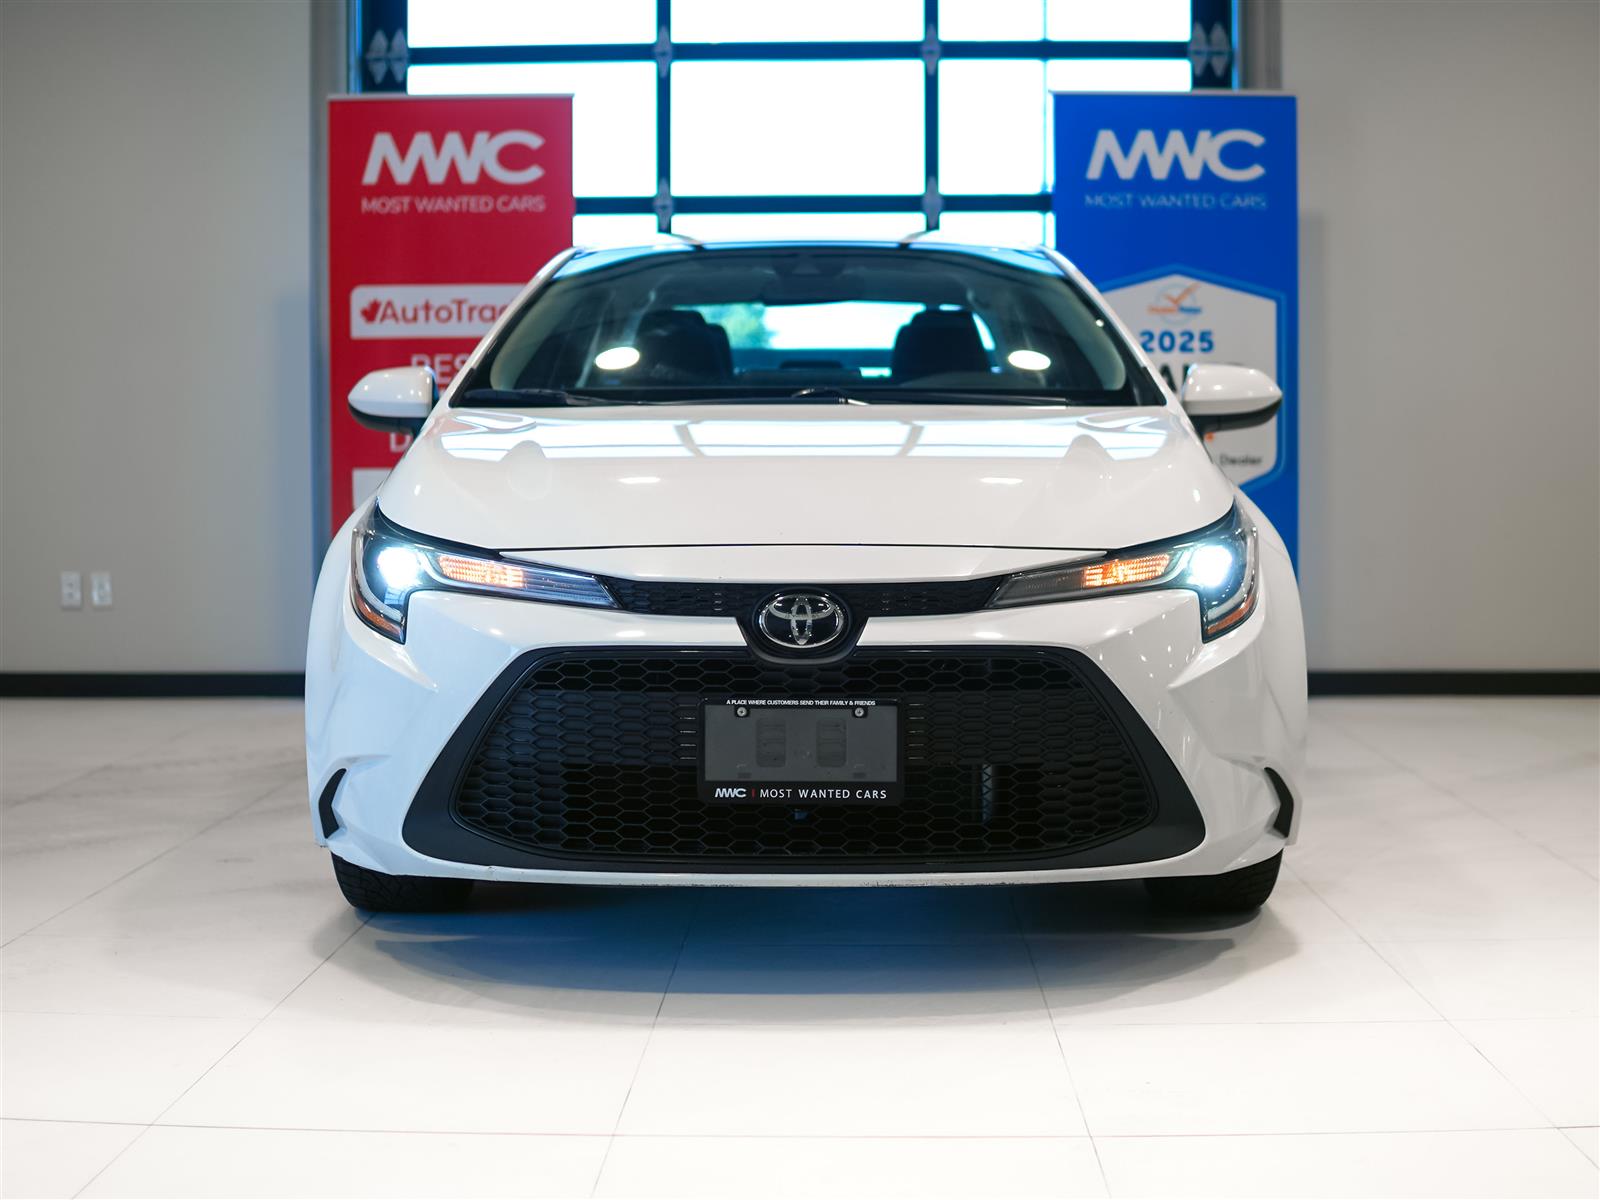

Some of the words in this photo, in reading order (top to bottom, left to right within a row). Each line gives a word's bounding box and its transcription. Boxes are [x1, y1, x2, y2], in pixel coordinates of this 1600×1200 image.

[361, 129, 545, 186] MWC
[1085, 128, 1266, 182] MWC
[361, 196, 410, 214] MOST
[416, 195, 494, 213] WANTED
[496, 195, 546, 212] CARS
[1140, 193, 1215, 209] WANTED
[1139, 330, 1214, 353] 2025
[760, 788, 792, 798] MOST
[799, 788, 850, 799] WANTED
[856, 789, 887, 799] CARS
